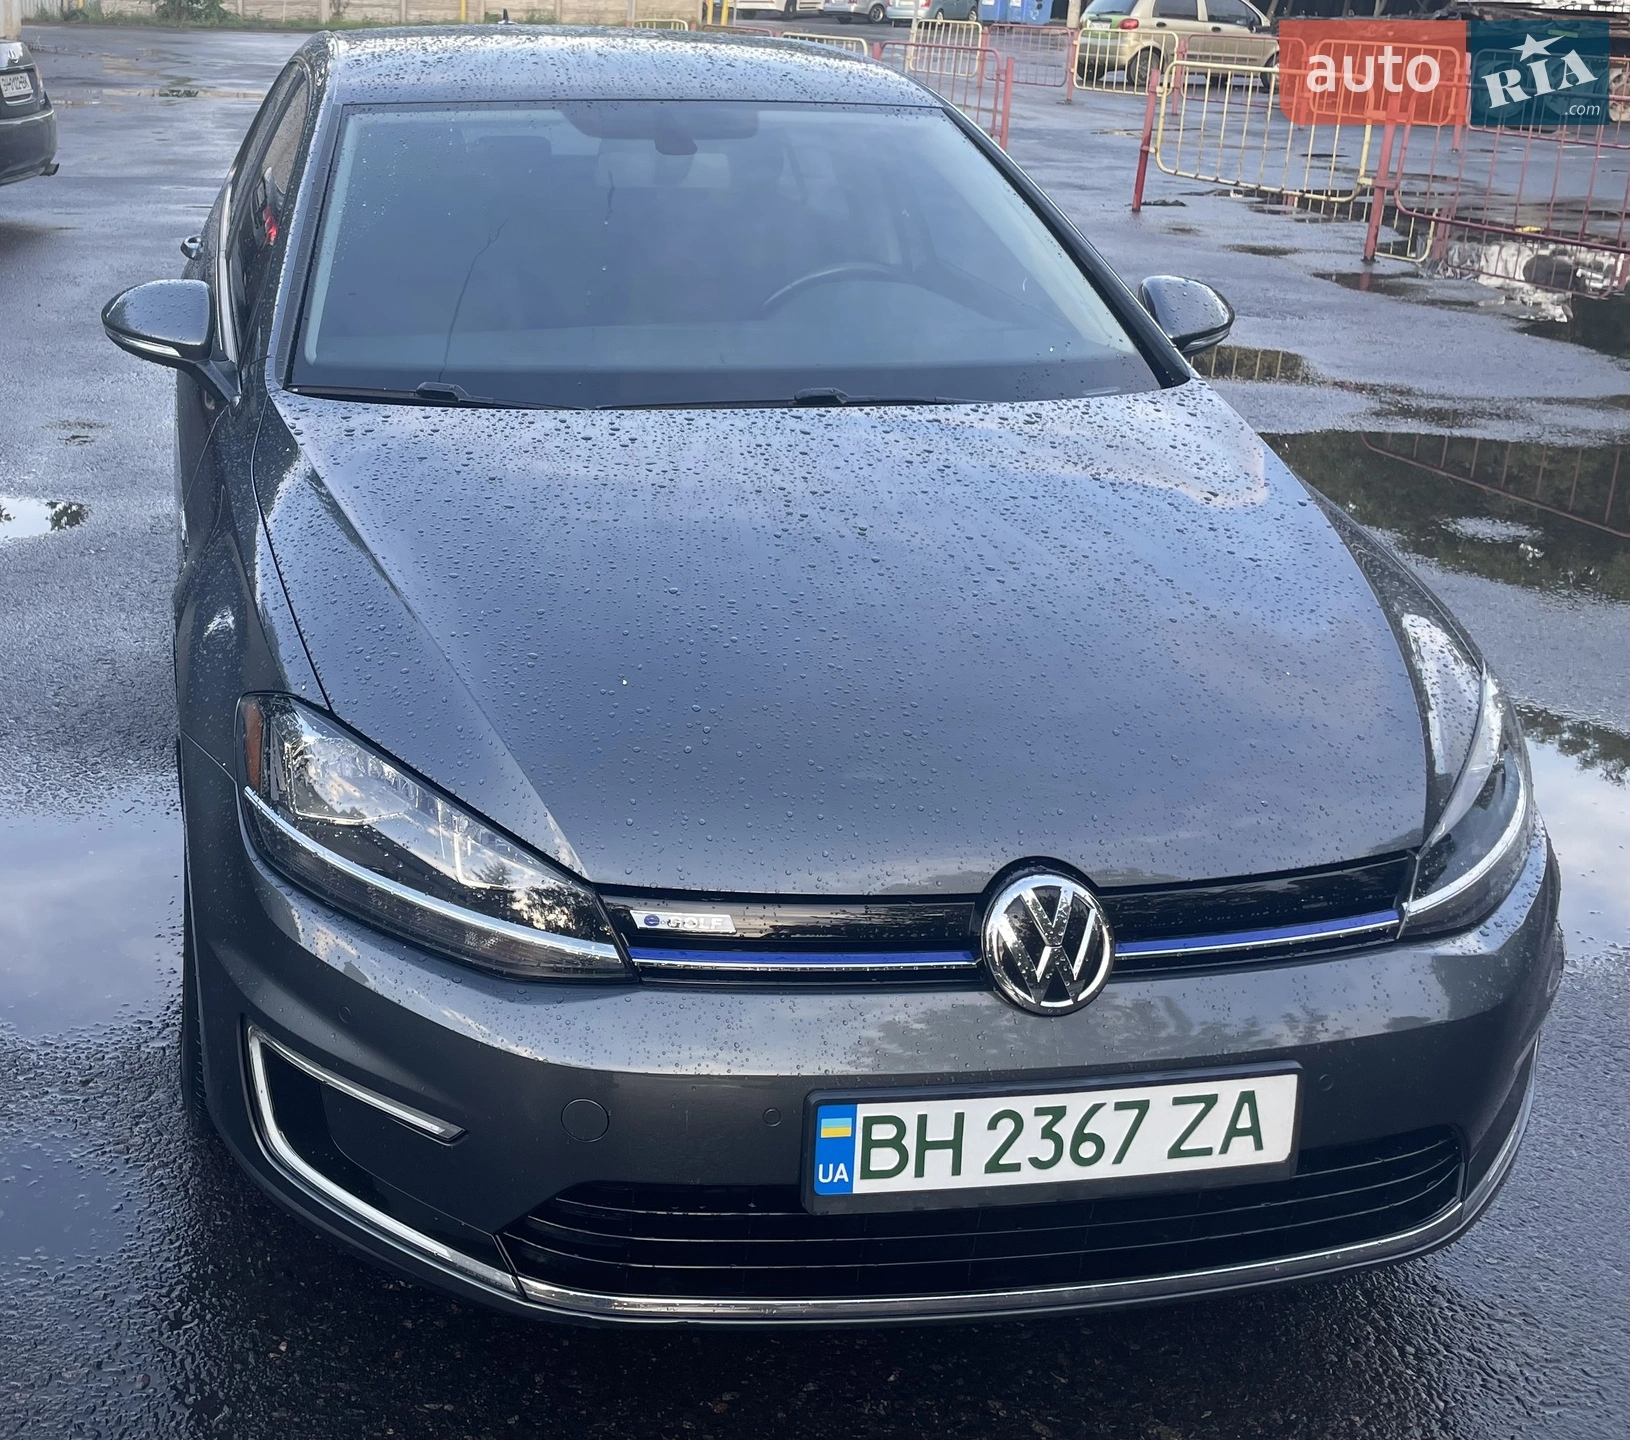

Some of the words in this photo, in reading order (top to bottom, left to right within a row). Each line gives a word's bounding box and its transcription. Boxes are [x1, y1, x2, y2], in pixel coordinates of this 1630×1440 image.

[859, 1111, 965, 1180] BH
[984, 1099, 1150, 1174] 2367
[1167, 1090, 1264, 1160] ZA
[818, 1162, 849, 1184] UA
